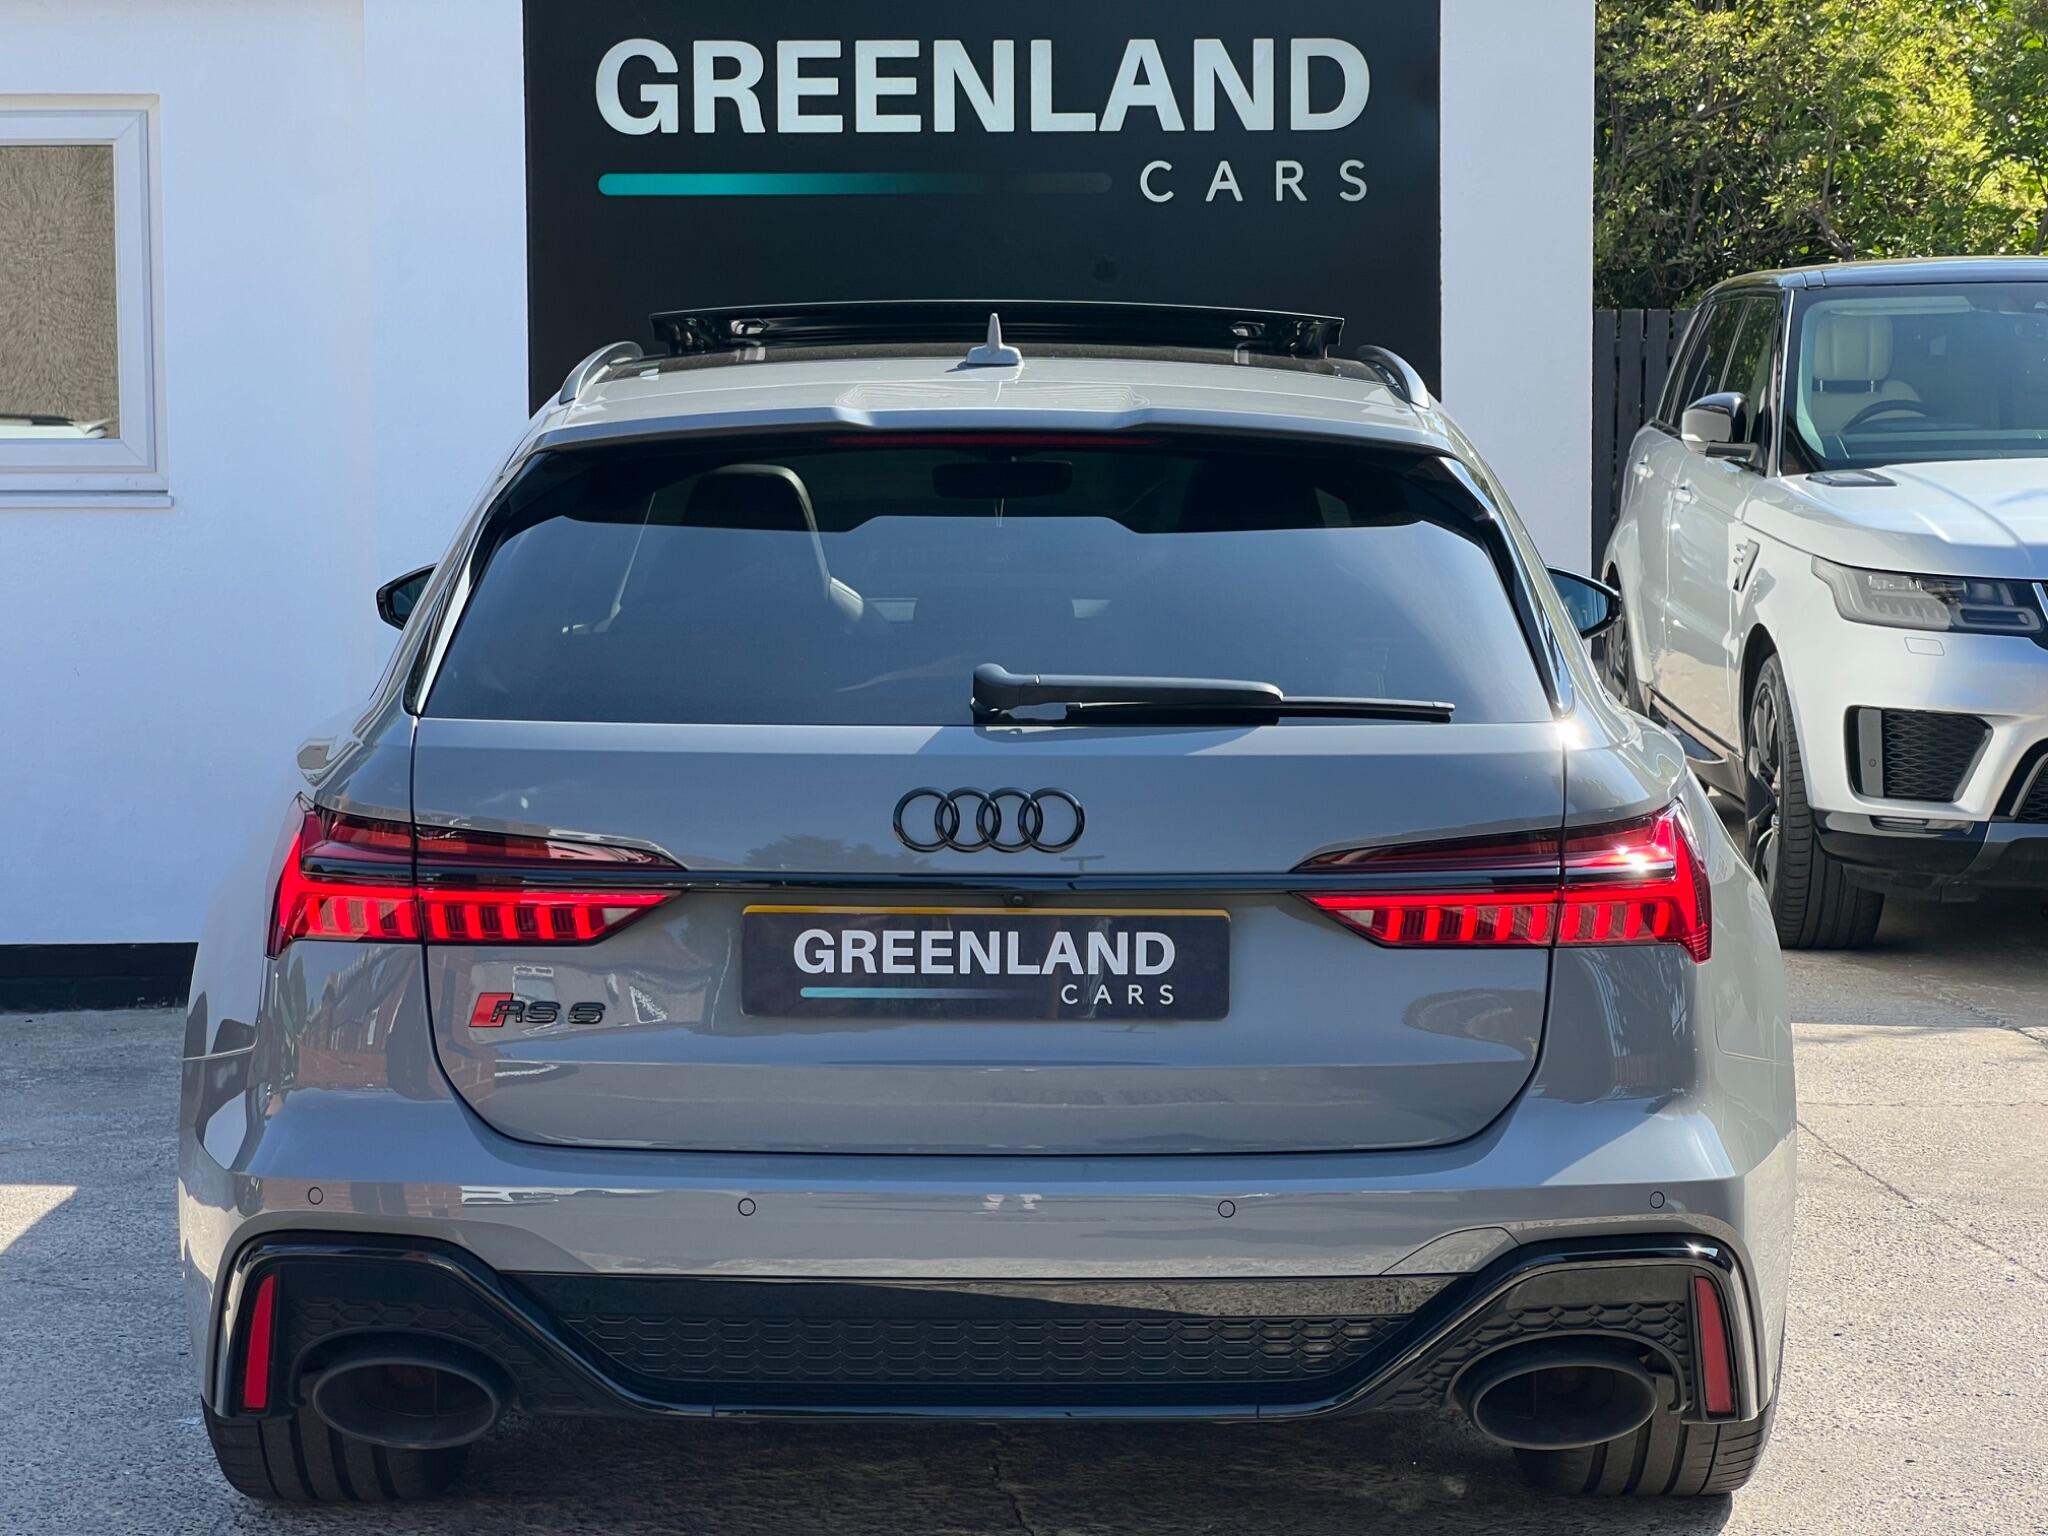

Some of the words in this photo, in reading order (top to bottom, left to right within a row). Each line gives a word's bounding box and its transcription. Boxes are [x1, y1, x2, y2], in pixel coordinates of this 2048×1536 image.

[595, 38, 1370, 135] GREENLAND
[1139, 159, 1367, 203] CARS
[793, 929, 1176, 976] GREENLAND
[1061, 984, 1174, 1006] CARS
